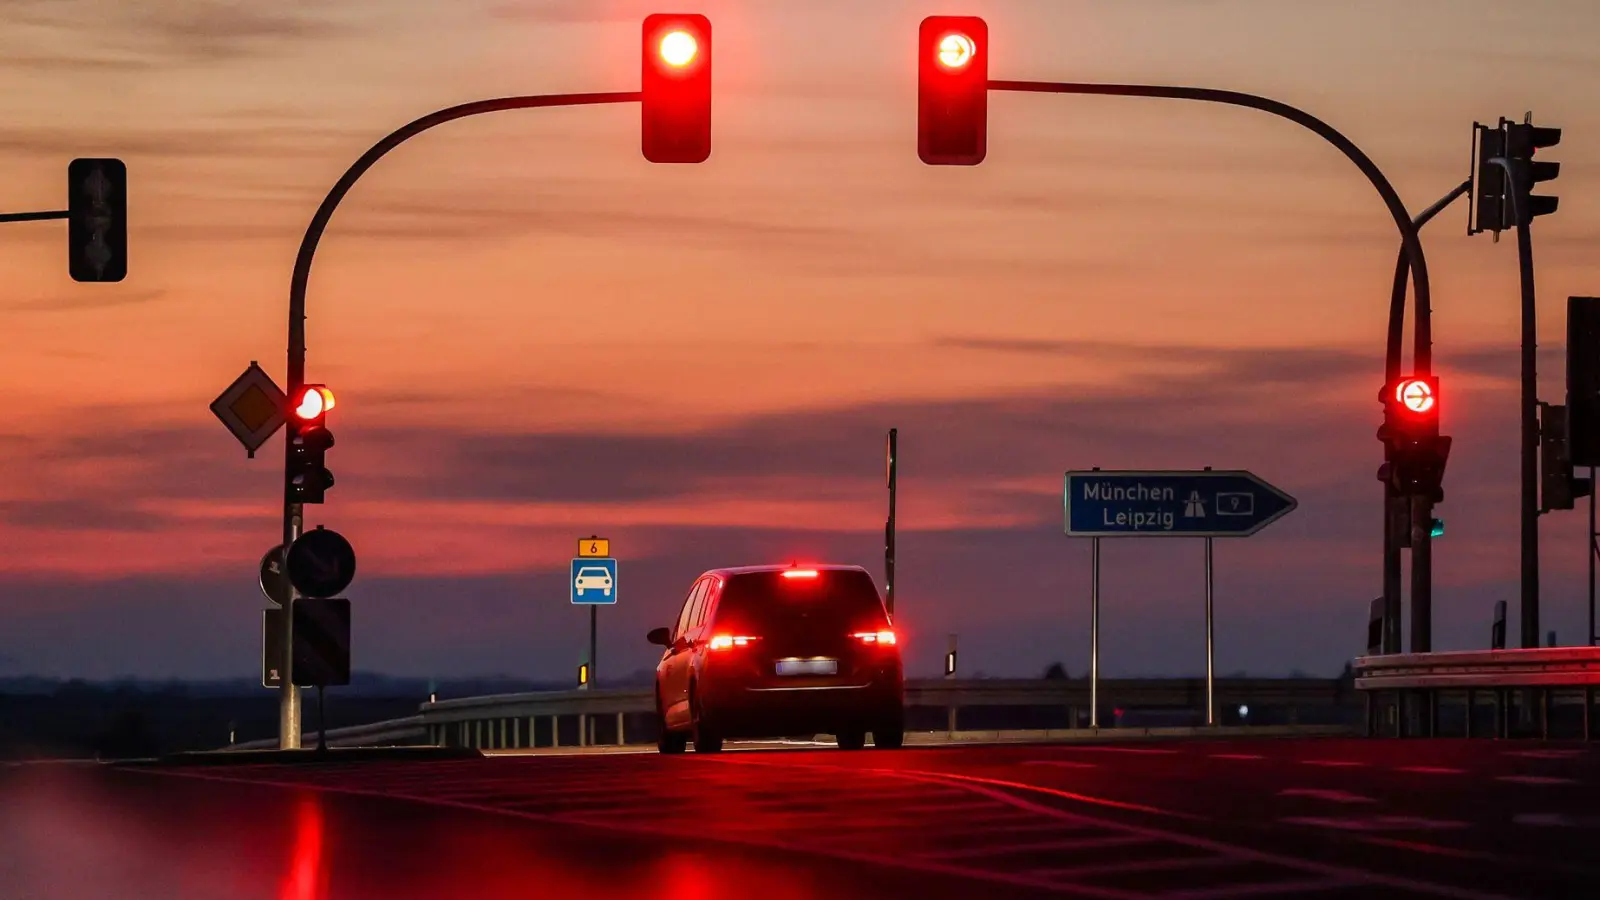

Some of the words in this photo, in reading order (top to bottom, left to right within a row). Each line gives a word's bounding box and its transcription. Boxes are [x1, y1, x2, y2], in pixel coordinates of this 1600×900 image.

[1083, 482, 1174, 501] München
[1230, 497, 1240, 510] 9
[1103, 508, 1174, 529] Leipzig
[590, 542, 598, 554] 6
